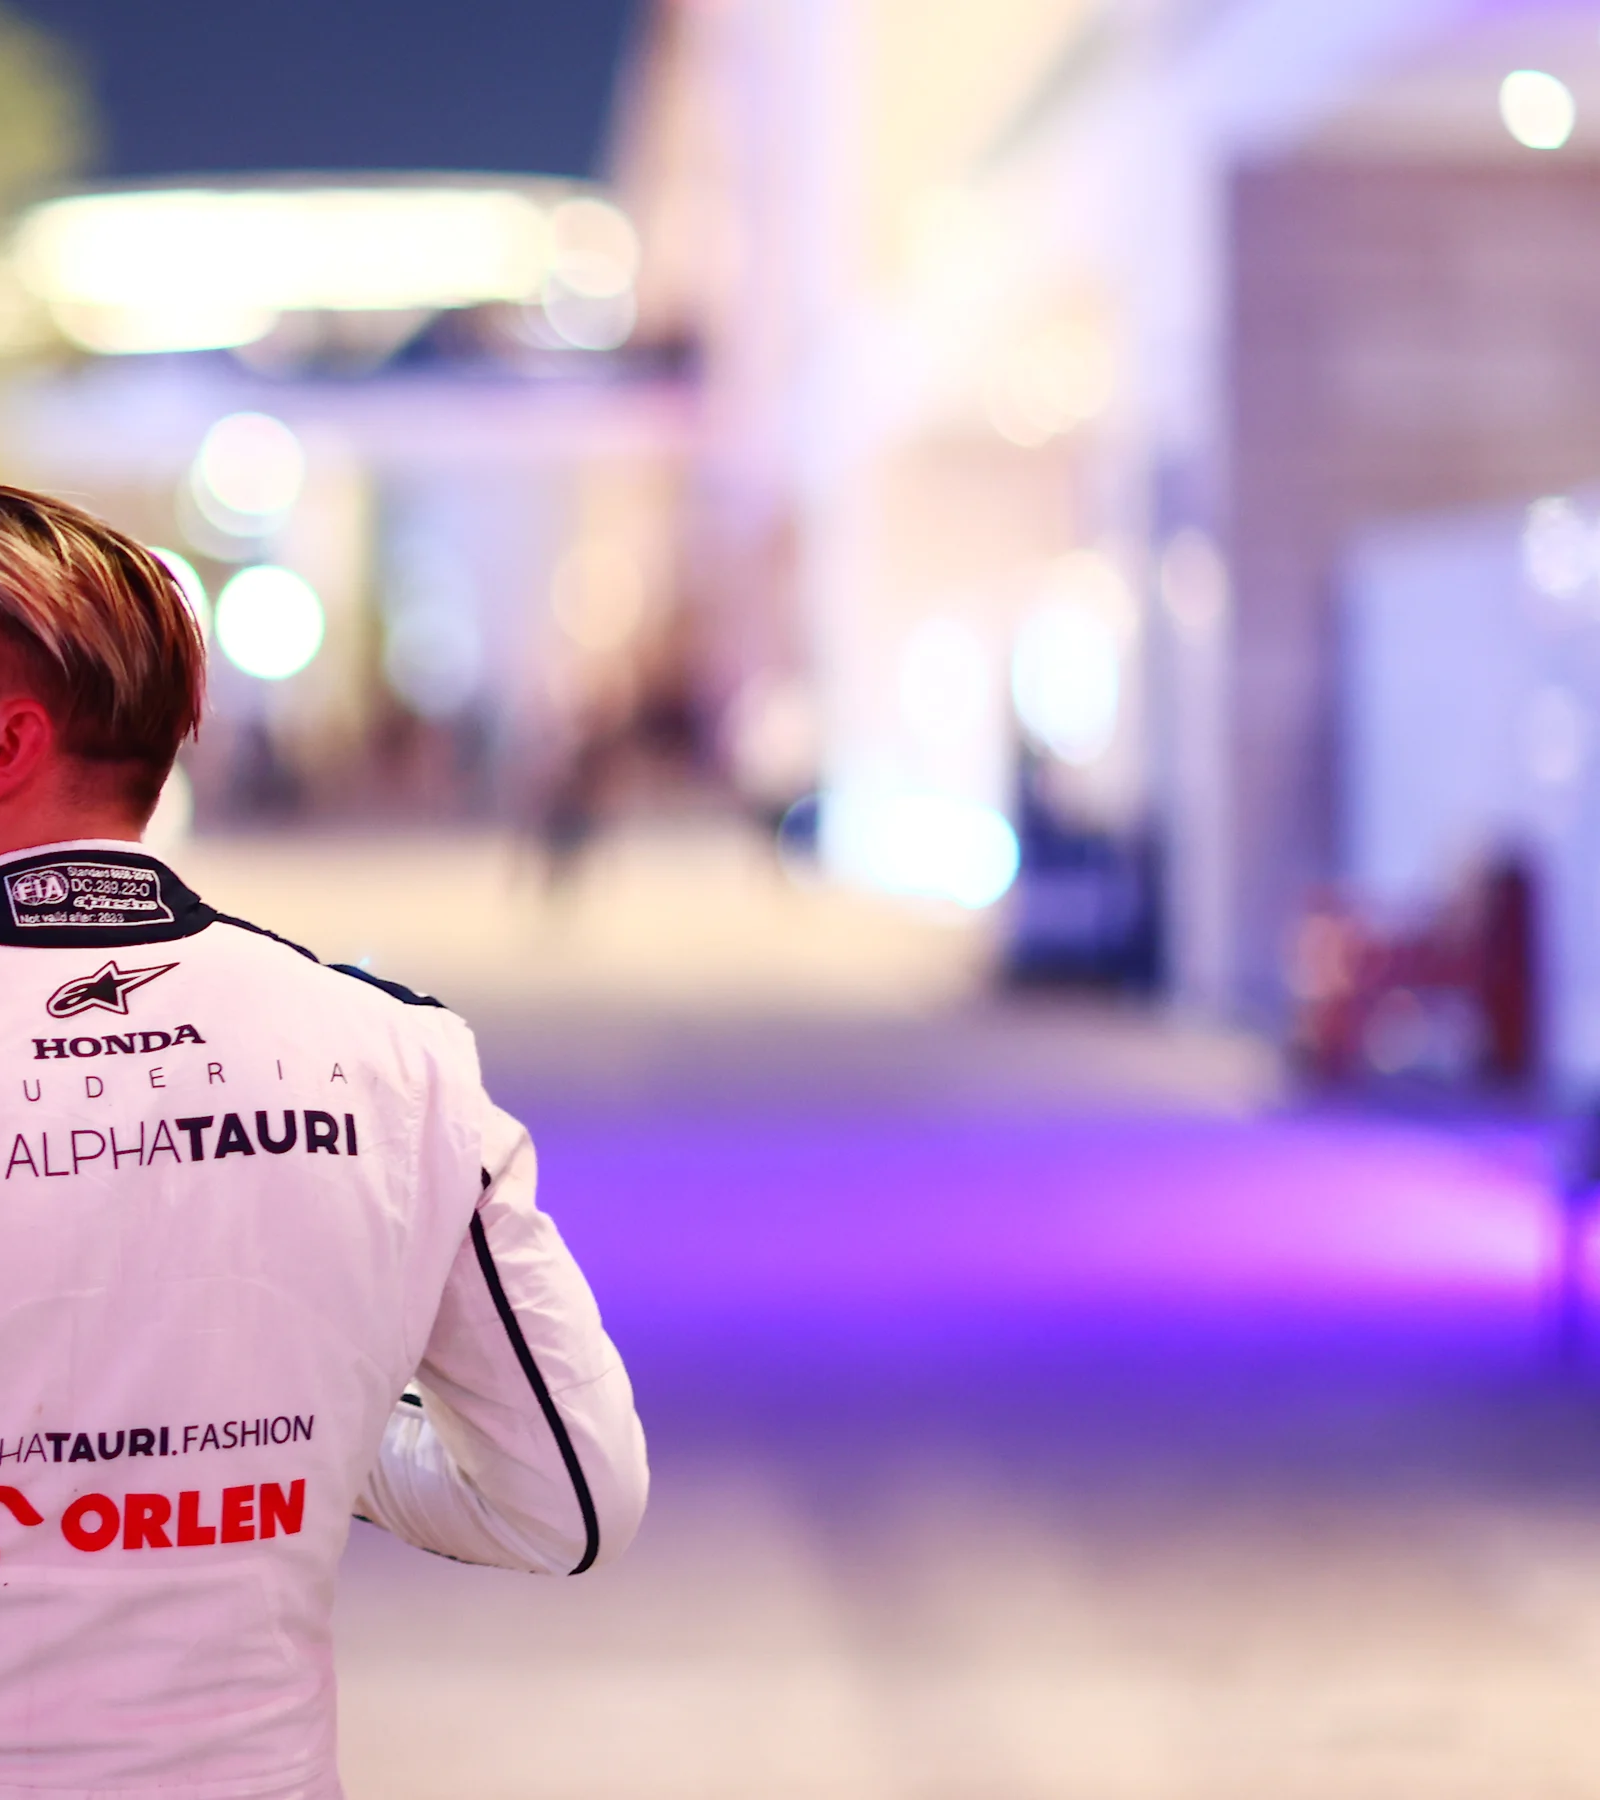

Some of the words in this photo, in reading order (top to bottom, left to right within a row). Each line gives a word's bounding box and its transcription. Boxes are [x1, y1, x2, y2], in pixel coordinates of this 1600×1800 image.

[17, 877, 63, 901] FIA
[20, 914, 41, 923] Not
[42, 911, 67, 923] valid
[31, 1024, 207, 1060] HONDA
[5, 1110, 358, 1180] ALPHATAURI
[59, 1478, 306, 1553] ORLEN
